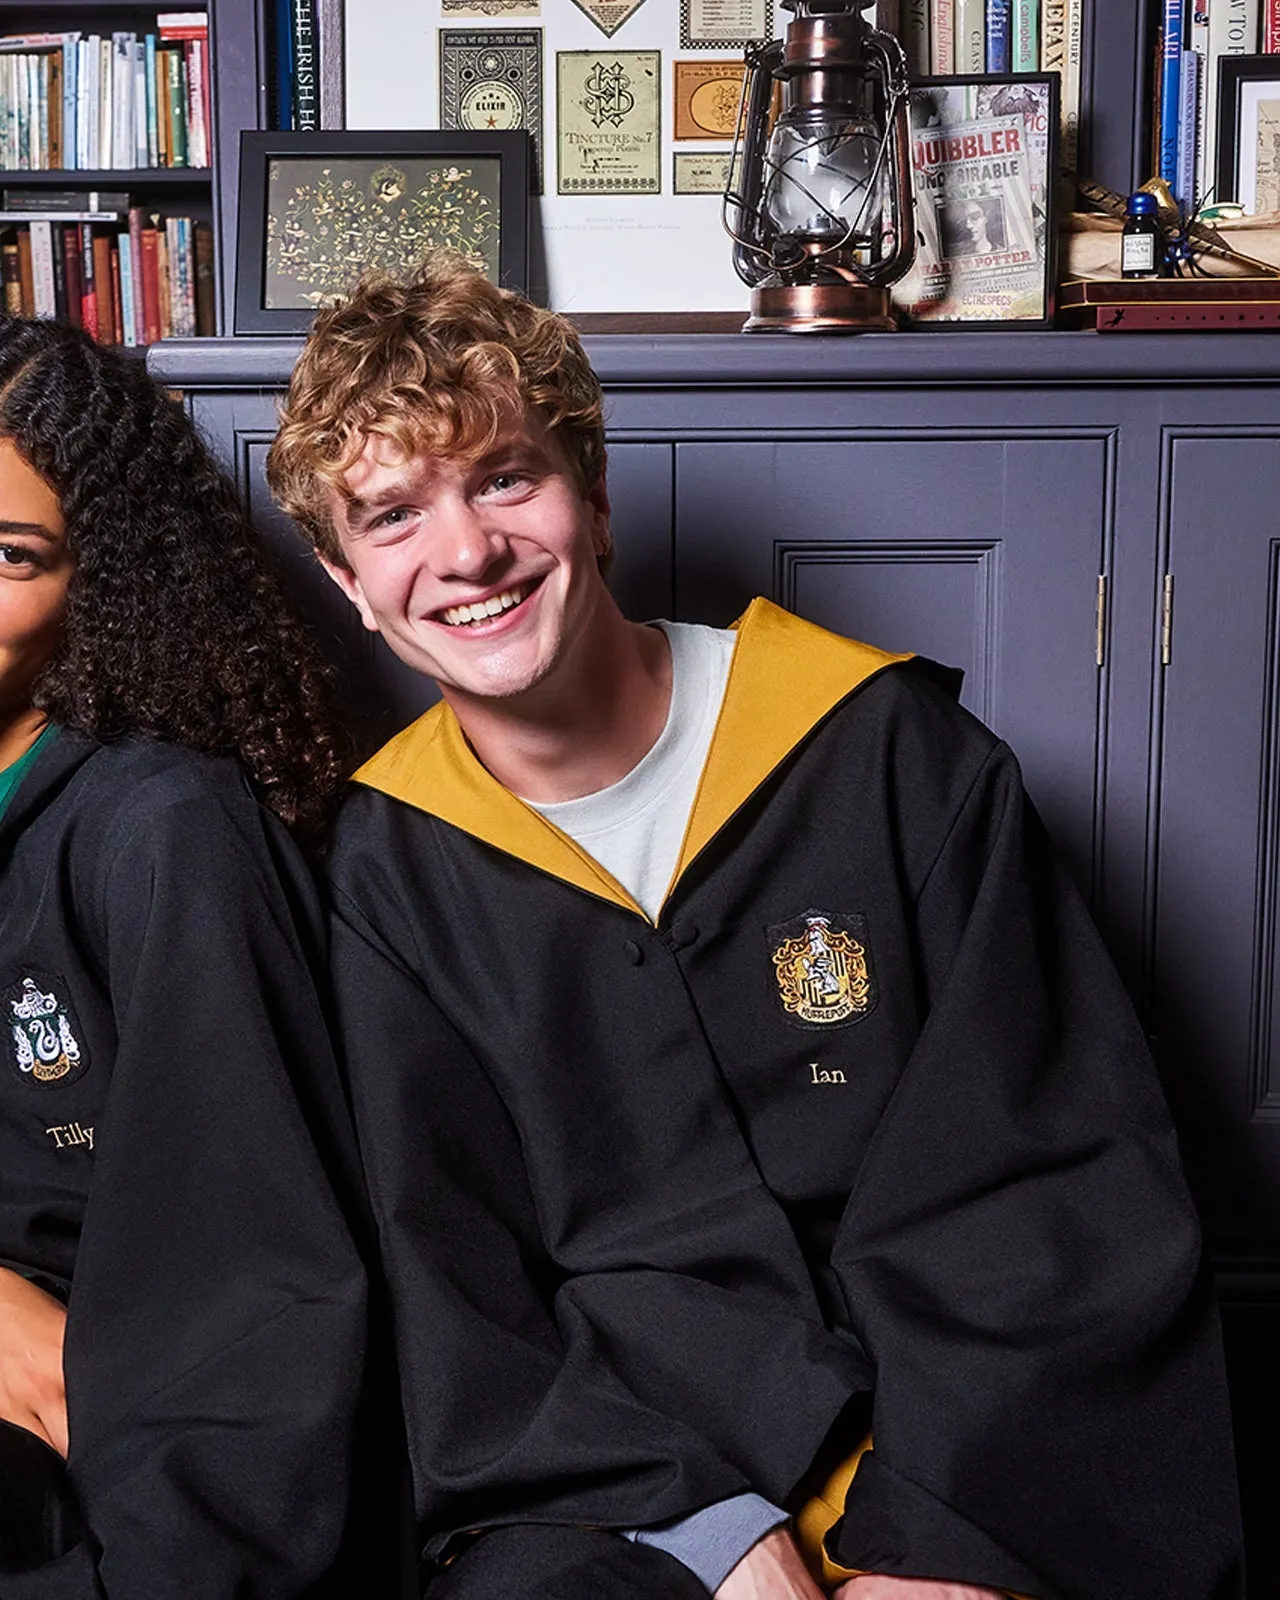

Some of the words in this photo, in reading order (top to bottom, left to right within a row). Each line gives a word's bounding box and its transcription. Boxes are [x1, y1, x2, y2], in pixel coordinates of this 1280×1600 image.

[295, 0, 311, 36] HE
[1228, 14, 1246, 41] TO
[1045, 2, 1065, 69] EFAX
[1071, 13, 1080, 66] CENTURY
[296, 44, 313, 100] IRISH
[475, 101, 506, 111] ELIXIR
[1186, 69, 1195, 121] HANDBOOK
[565, 132, 630, 144] TINCTURE
[912, 128, 1020, 175] QUIBBLER
[974, 250, 1032, 269] POTTER
[801, 1003, 851, 1021] HUFFLEPUFF
[808, 1062, 848, 1085] Ian
[45, 1121, 95, 1150] Tilly
